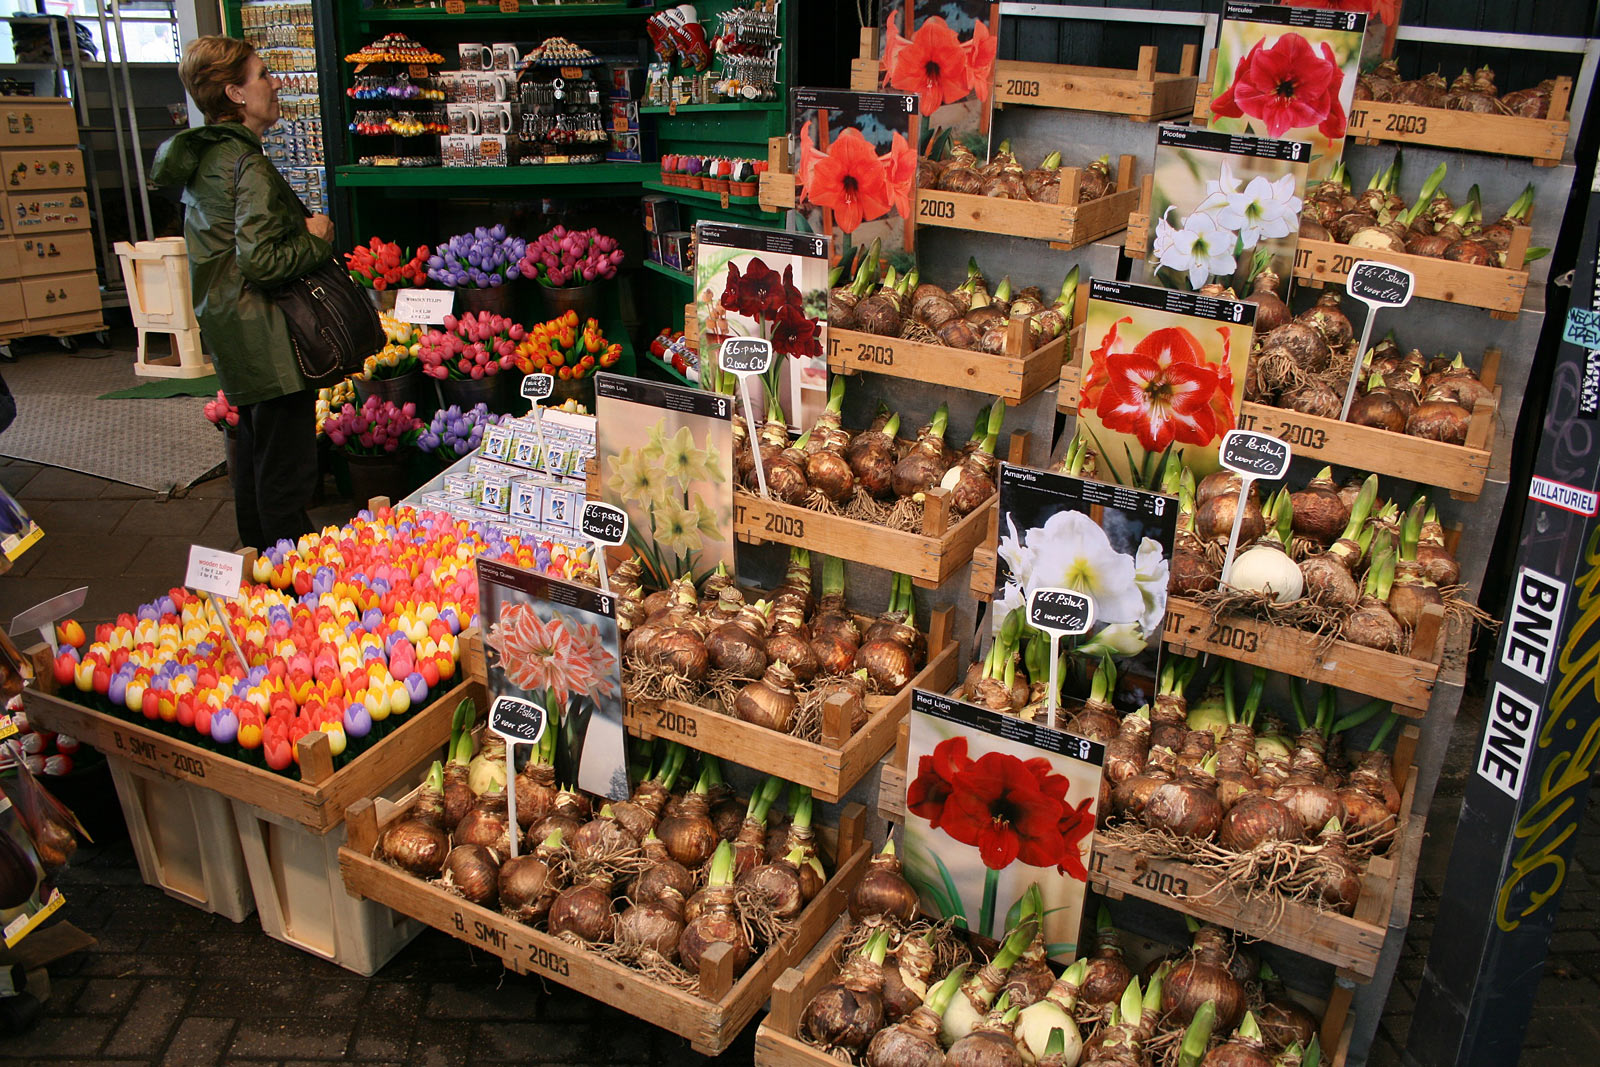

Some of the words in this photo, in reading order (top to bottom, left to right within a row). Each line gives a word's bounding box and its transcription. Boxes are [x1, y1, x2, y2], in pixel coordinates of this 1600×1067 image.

[1227, 6, 1253, 14] Hercules
[1006, 80, 1040, 97] 2003
[1349, 110, 1368, 128] MIT
[1386, 114, 1427, 134] 2003
[1162, 130, 1186, 139] Picotee
[920, 199, 955, 219] 2003
[1331, 254, 1373, 275] 20
[1093, 284, 1120, 294] Minerva
[1352, 280, 1362, 292] 2
[1364, 285, 1380, 296] voor
[726, 356, 734, 368] 2
[857, 343, 894, 366] 2003
[599, 382, 616, 390] Lemon
[616, 384, 628, 392] Lime
[1278, 422, 1326, 450] 2003
[1226, 450, 1234, 462] 2
[1234, 456, 1253, 465] voor
[1260, 442, 1285, 459] stuk
[1004, 469, 1037, 482] Amaryllis
[1532, 480, 1594, 512] VILLATURIEL
[583, 520, 590, 530] 2
[590, 526, 604, 534] voor
[764, 512, 805, 538] 2003
[480, 565, 499, 576] Dancing
[500, 570, 515, 580] Queen
[1032, 608, 1042, 620] 2
[1044, 614, 1060, 624] voor
[1507, 575, 1560, 681] BNE
[1207, 624, 1258, 653] 2003
[916, 694, 932, 705] Red
[934, 699, 951, 711] Lion
[493, 713, 501, 726] 2
[500, 719, 516, 729] voor
[656, 710, 698, 738] 2003
[1482, 690, 1533, 792] BNE
[113, 731, 127, 750] B.
[128, 736, 156, 761] SMIT
[172, 751, 206, 778] 2003
[1132, 863, 1189, 901] 2003
[454, 912, 468, 934] B.
[474, 921, 508, 950] SMIT
[528, 943, 570, 977] 2003
